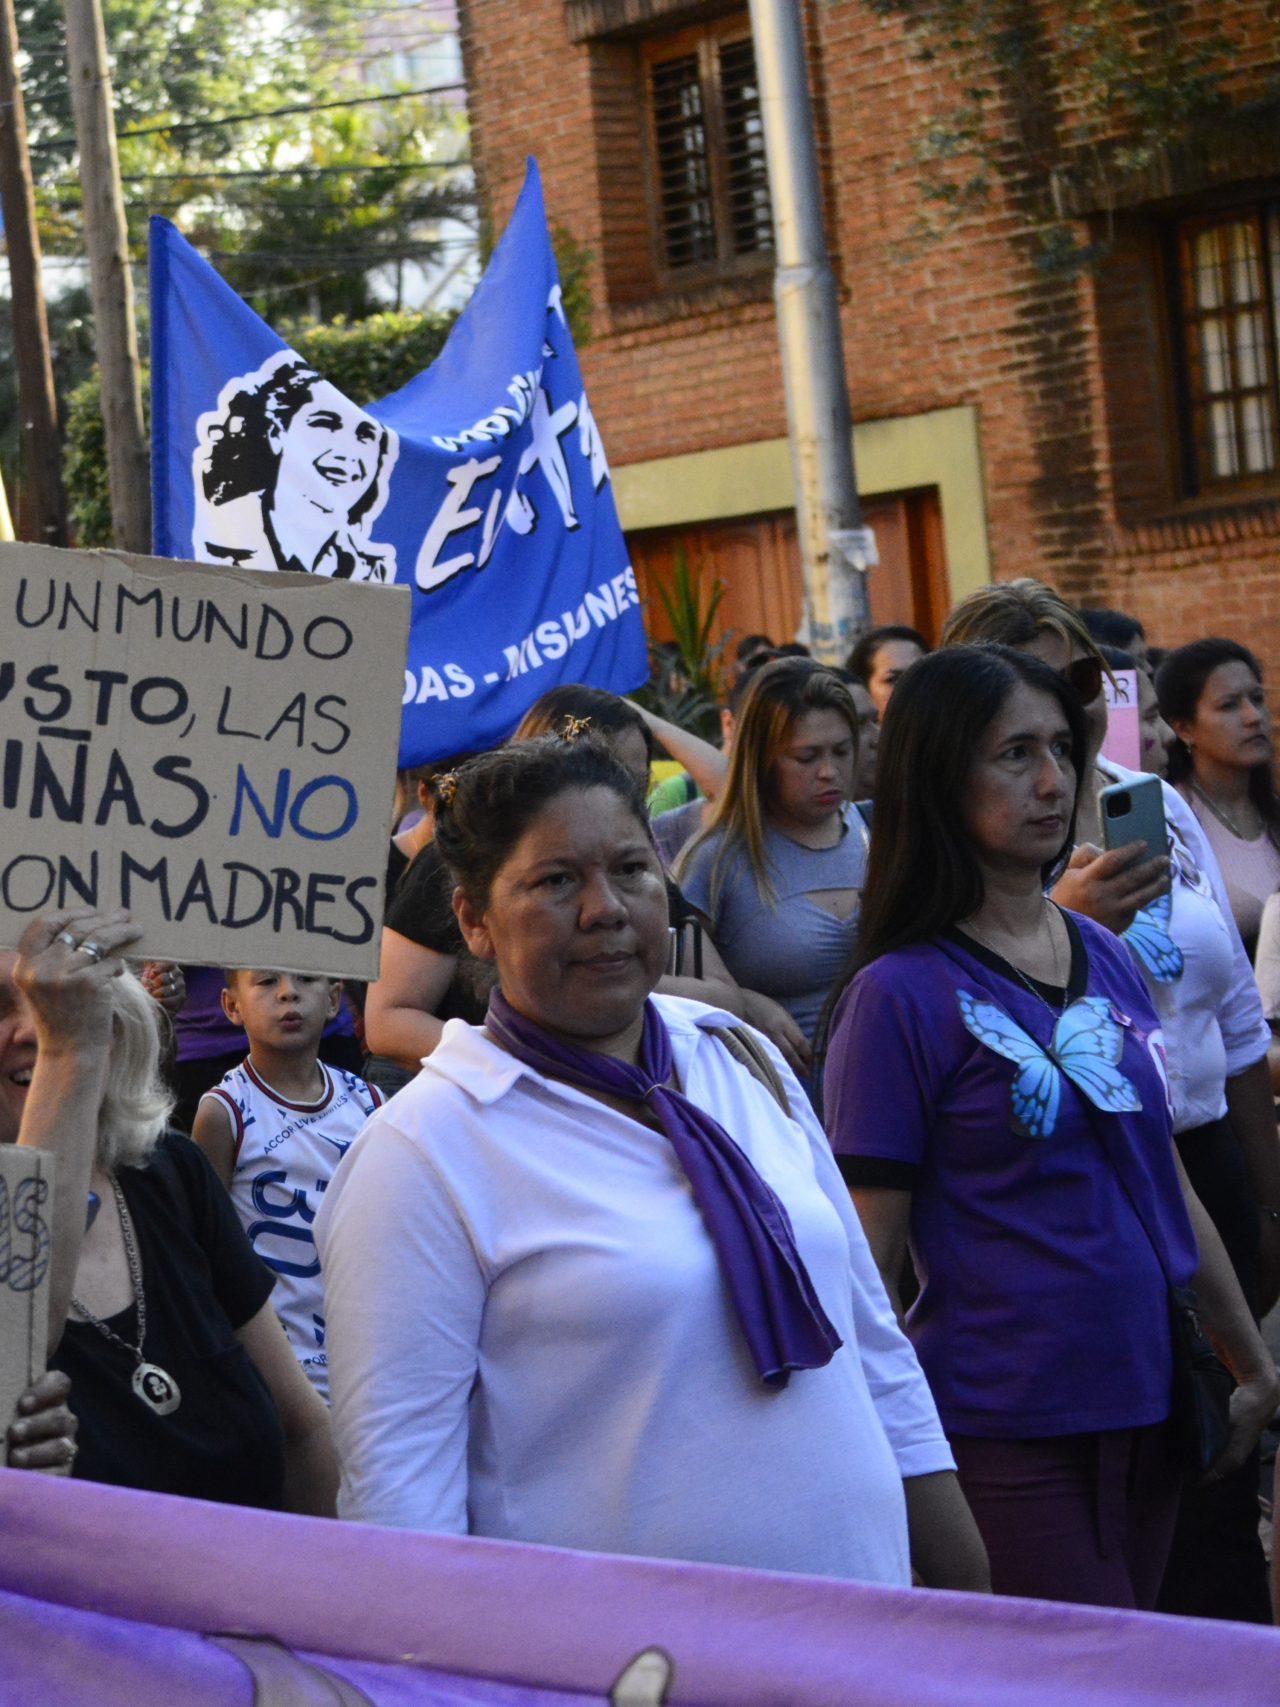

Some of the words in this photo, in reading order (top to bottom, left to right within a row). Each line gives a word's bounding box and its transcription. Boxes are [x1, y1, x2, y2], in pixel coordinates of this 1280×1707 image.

[16, 577, 101, 633] UN
[116, 583, 354, 661] MUNDO
[217, 686, 352, 755] LAS
[228, 763, 359, 841] NO
[121, 850, 378, 945] MADRES
